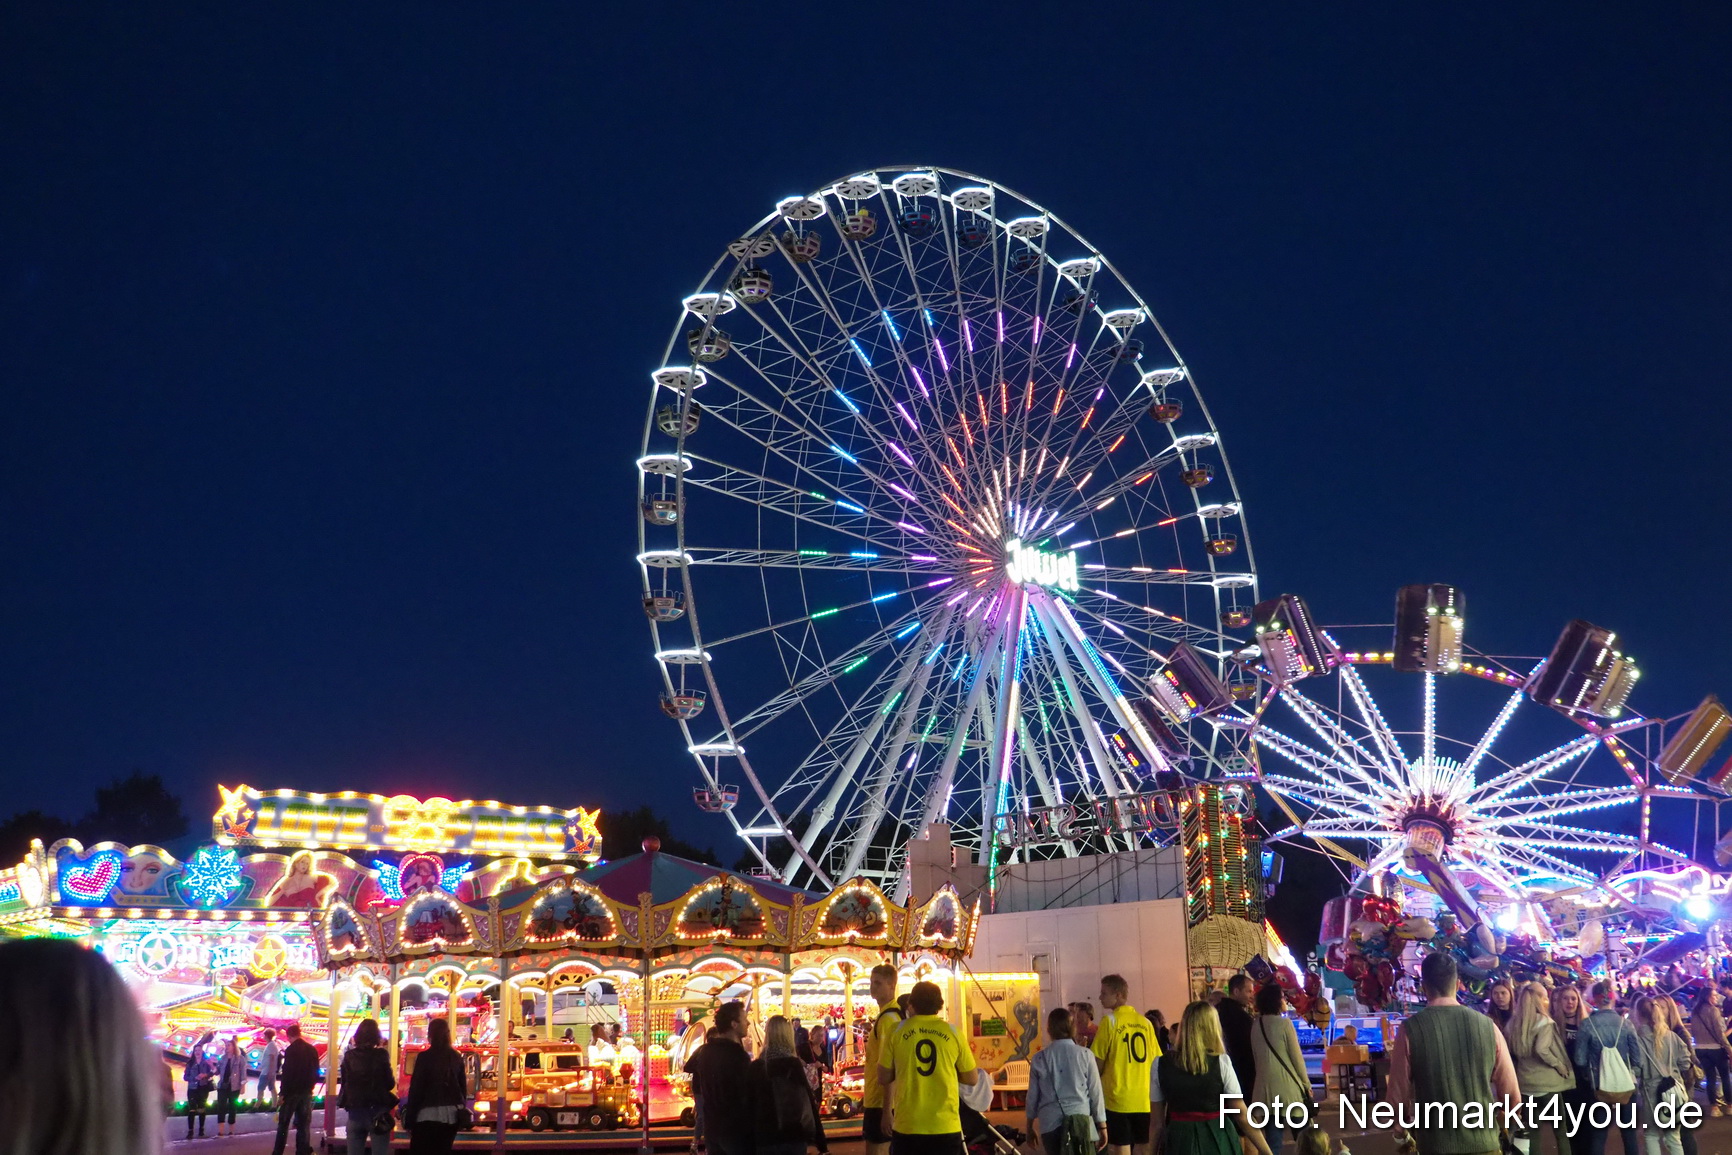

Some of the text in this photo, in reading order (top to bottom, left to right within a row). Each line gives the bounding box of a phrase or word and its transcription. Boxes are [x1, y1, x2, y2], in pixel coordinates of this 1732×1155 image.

[902, 1027, 950, 1042] DJK Neumarkt
[1122, 1031, 1147, 1063] 10
[915, 1038, 937, 1076] 9
